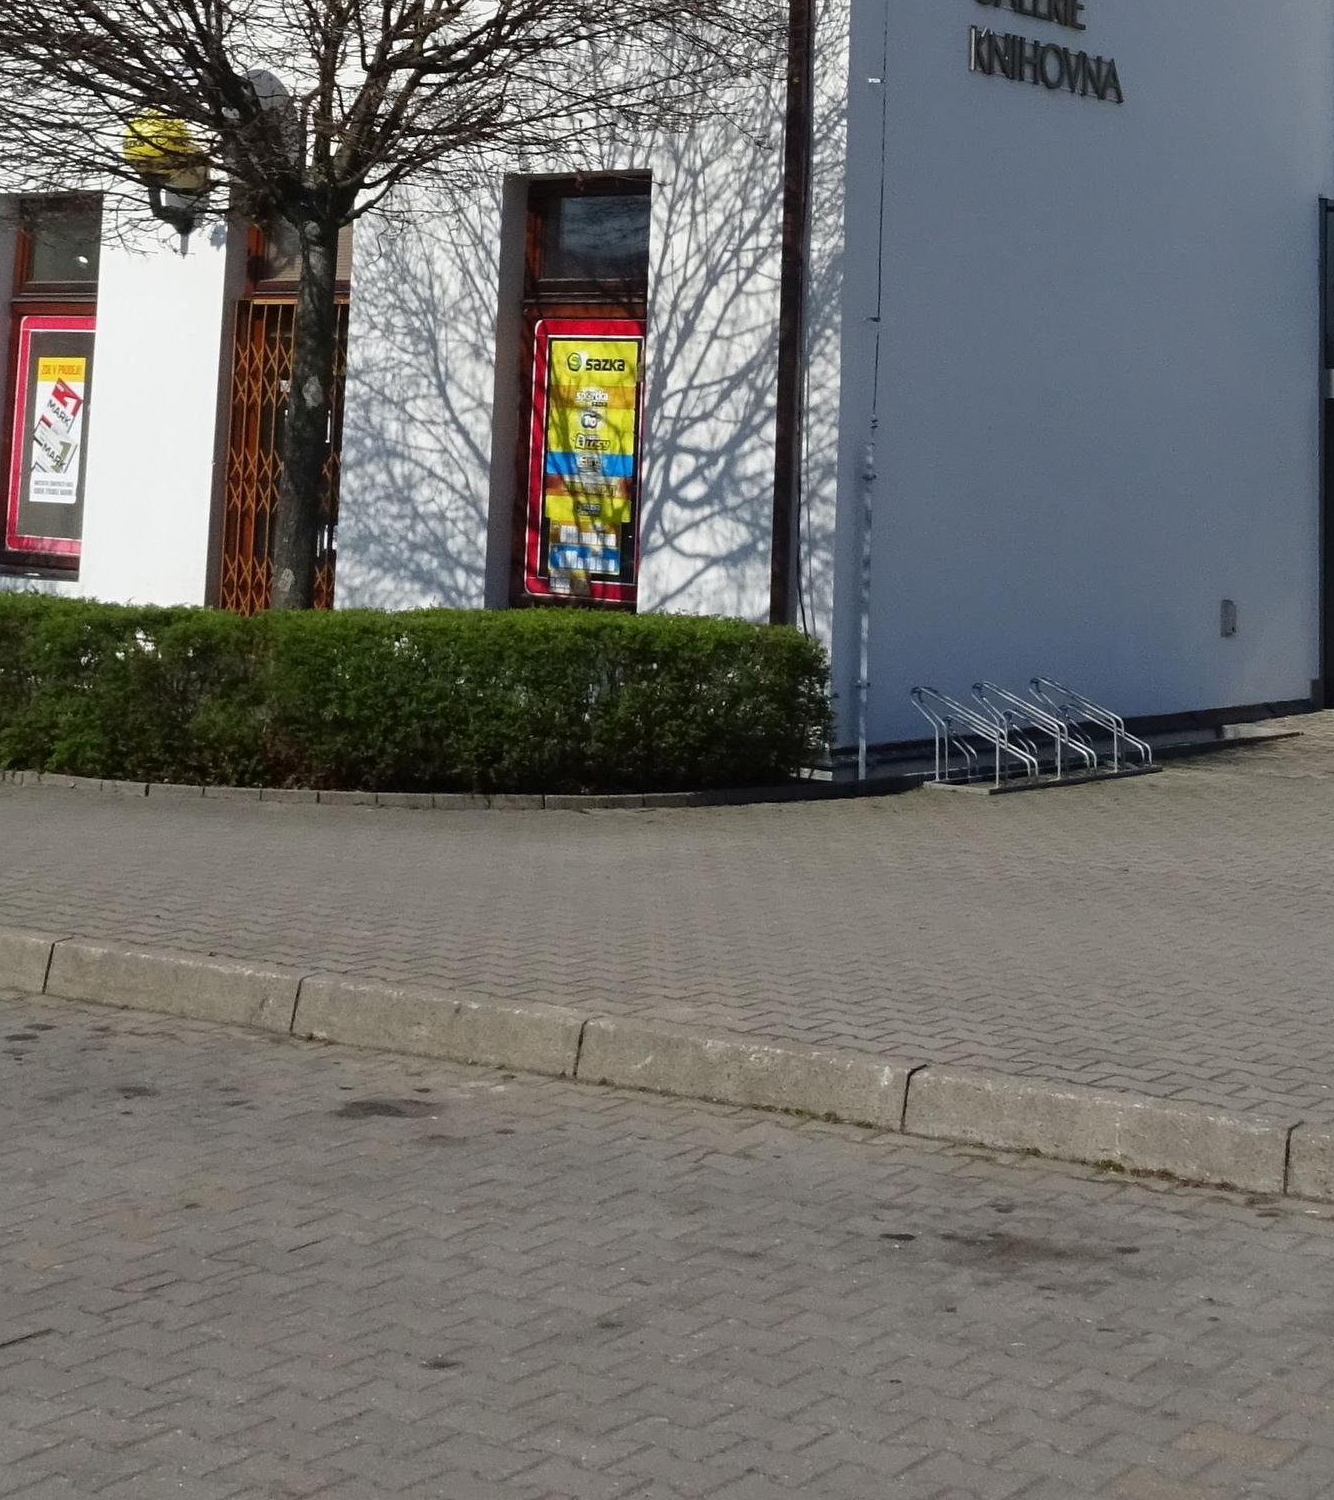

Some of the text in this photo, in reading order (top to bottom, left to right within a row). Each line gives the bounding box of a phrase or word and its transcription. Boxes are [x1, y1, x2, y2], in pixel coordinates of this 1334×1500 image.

[969, 24, 1125, 104] KNIHOVNA
[46, 398, 72, 427] MARK
[41, 442, 67, 470] MARK
